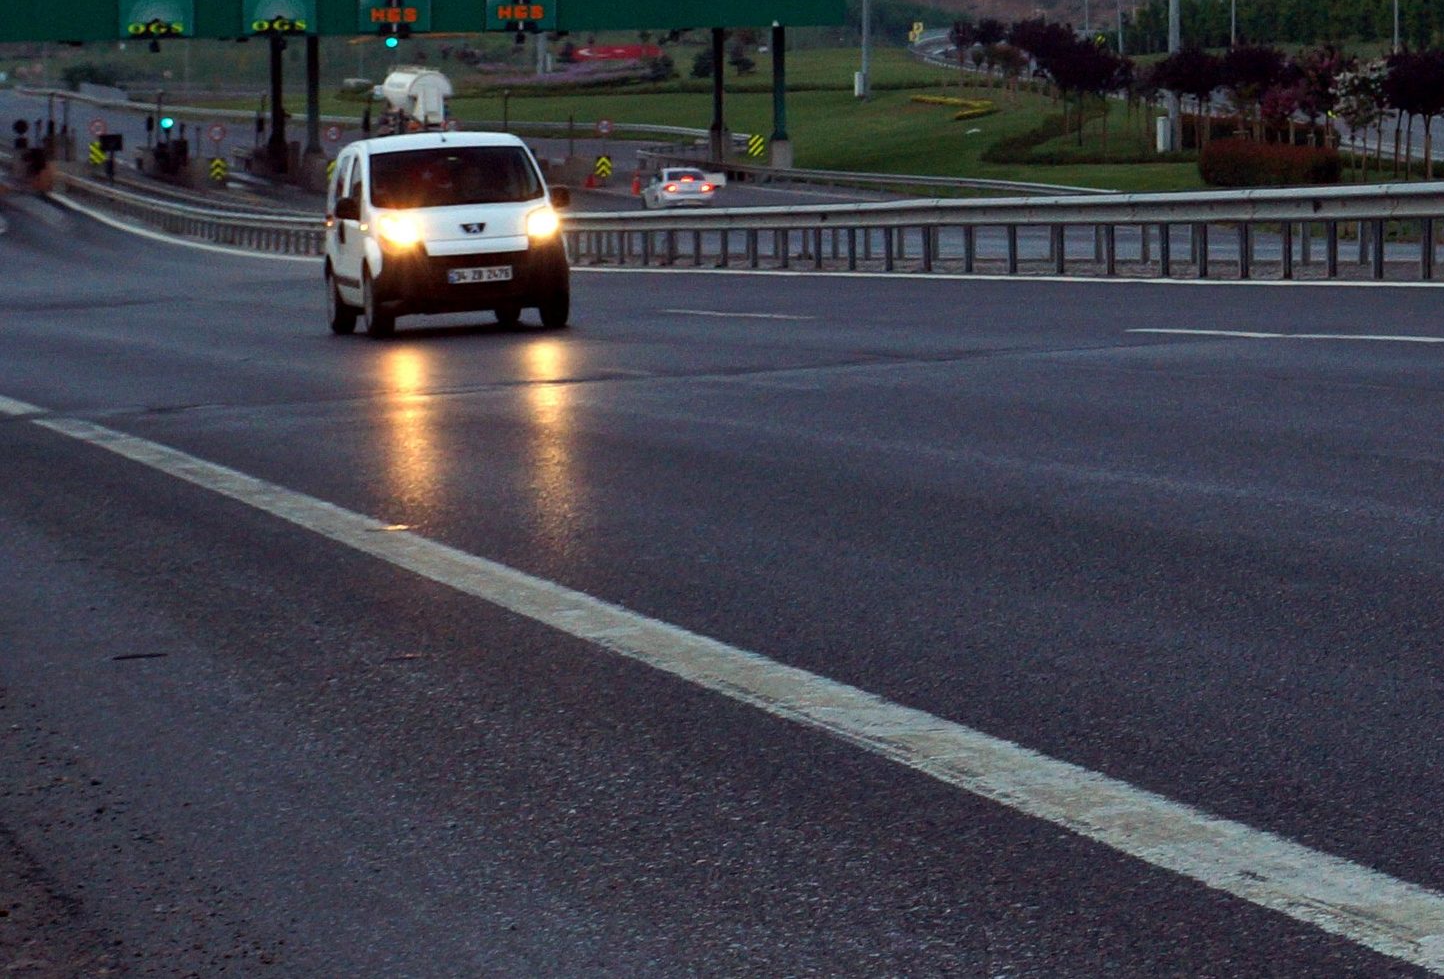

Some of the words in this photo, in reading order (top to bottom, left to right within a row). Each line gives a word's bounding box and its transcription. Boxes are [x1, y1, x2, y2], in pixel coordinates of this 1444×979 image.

[371, 7, 417, 23] HGS
[497, 4, 545, 20] HGS
[127, 22, 184, 35] OGS
[252, 19, 307, 32] OGS
